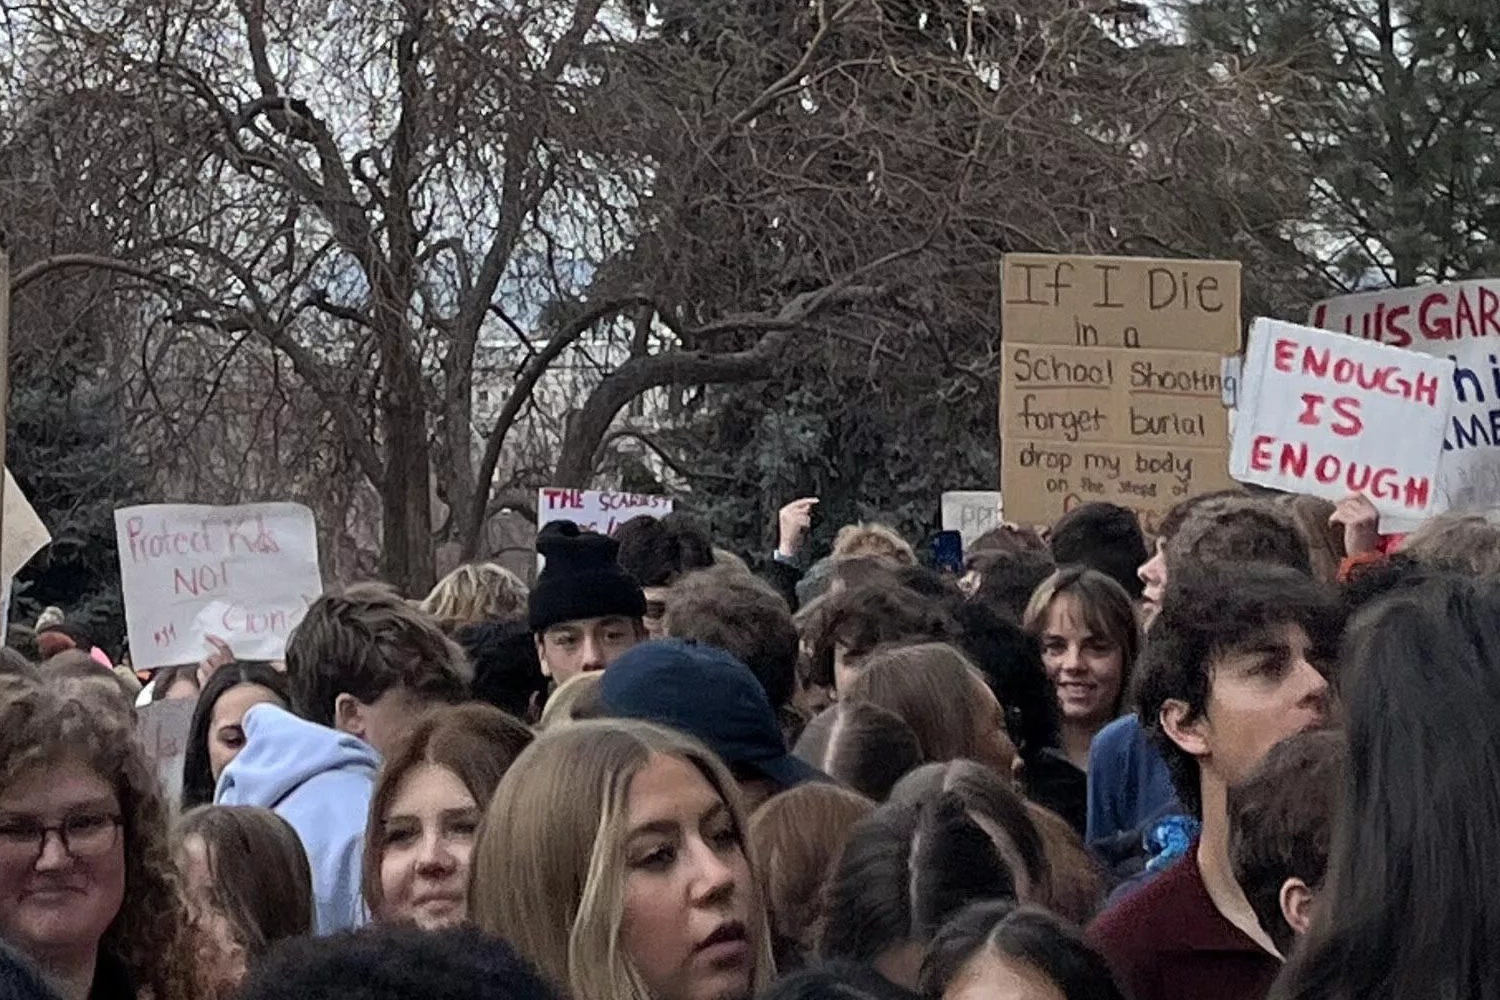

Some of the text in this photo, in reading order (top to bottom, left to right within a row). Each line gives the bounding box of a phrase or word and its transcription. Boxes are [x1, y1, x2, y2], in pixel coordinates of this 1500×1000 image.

[1005, 261, 1076, 307] If
[1092, 263, 1125, 308] I
[1123, 325, 1141, 349] a
[1012, 348, 1114, 385] School
[1273, 338, 1439, 406] ENOUGH
[1018, 393, 1205, 441] forget burial
[1297, 392, 1364, 436] IS
[1019, 442, 1193, 482] drop my body
[1250, 434, 1429, 509] ENOUGH
[543, 487, 585, 510] THE
[1046, 477, 1068, 493] on
